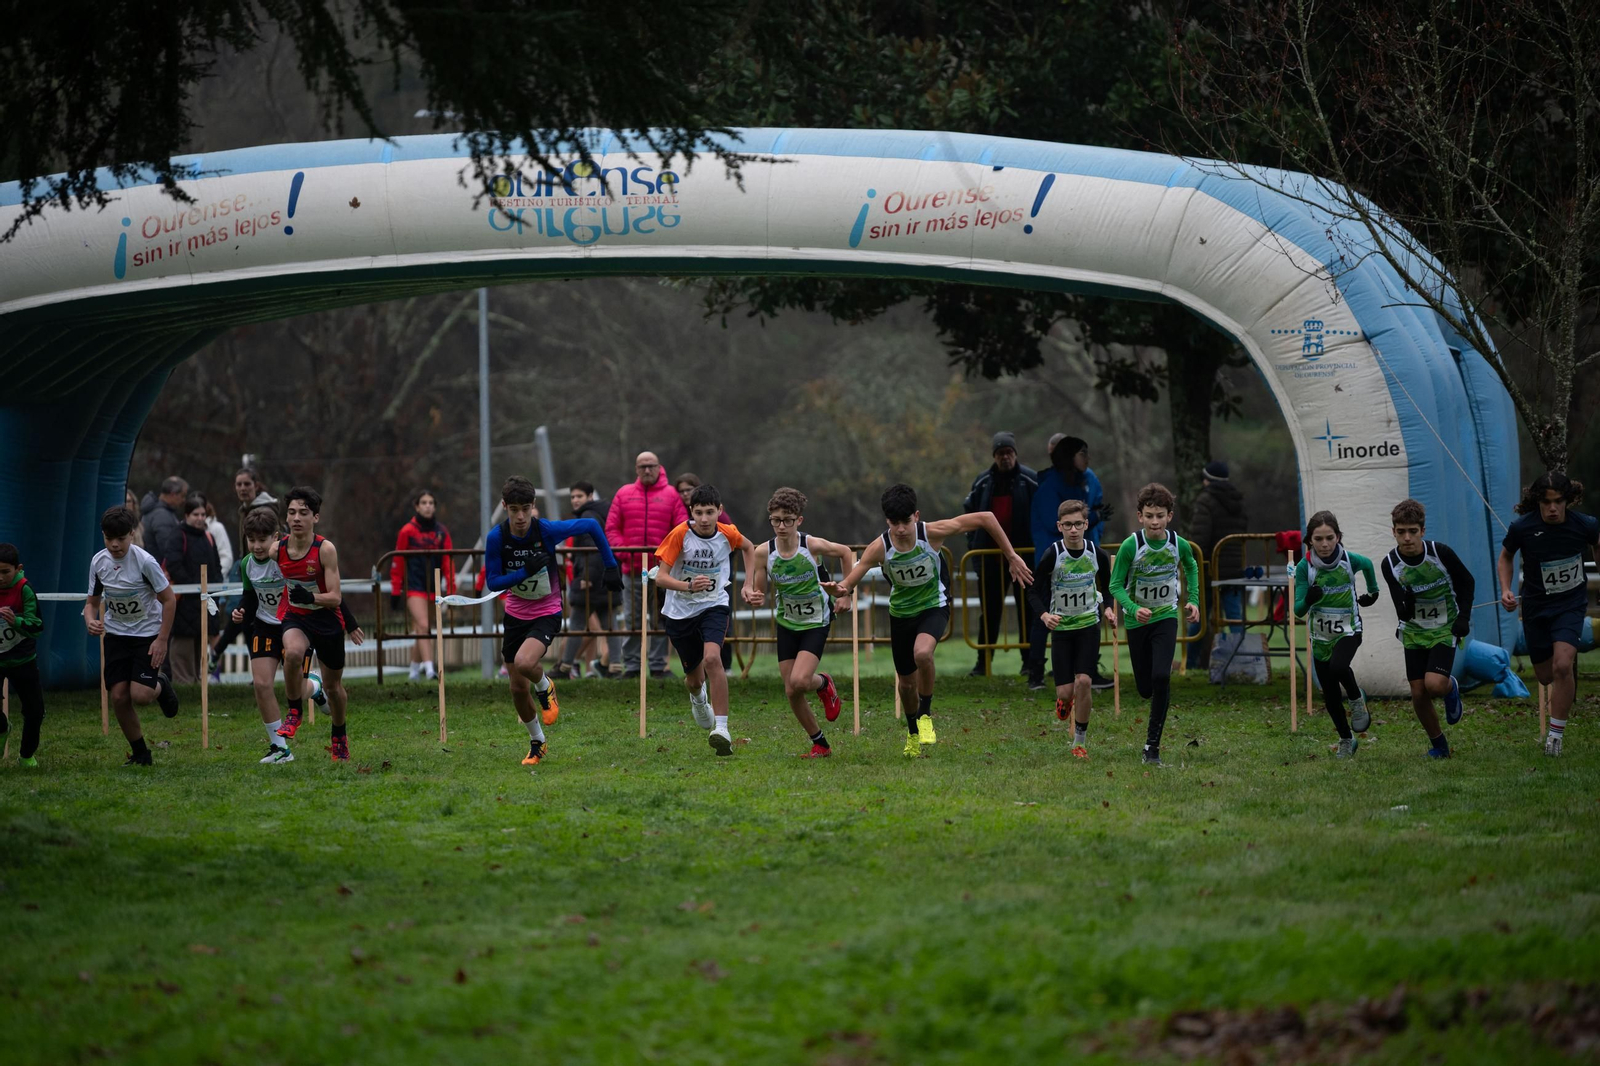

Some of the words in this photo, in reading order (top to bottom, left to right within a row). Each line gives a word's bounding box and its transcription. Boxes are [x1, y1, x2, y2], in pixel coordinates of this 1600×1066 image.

[489, 198, 544, 207] ESTINO
[626, 195, 680, 205] TERMAL
[869, 220, 900, 239] sin
[906, 217, 921, 235] ir
[925, 212, 969, 234] más
[975, 207, 1024, 229] lejos
[133, 246, 162, 267] sin
[168, 239, 182, 257] ir
[188, 226, 229, 251] más
[234, 210, 281, 237] lejos
[1337, 441, 1400, 459] inorde
[694, 549, 714, 559] ANA
[896, 565, 928, 581] 112
[1545, 564, 1579, 586] 457
[1060, 592, 1086, 607] 111
[1140, 585, 1169, 600] 110
[108, 601, 141, 615] 482
[785, 602, 815, 615] 113
[1317, 618, 1345, 634] 115
